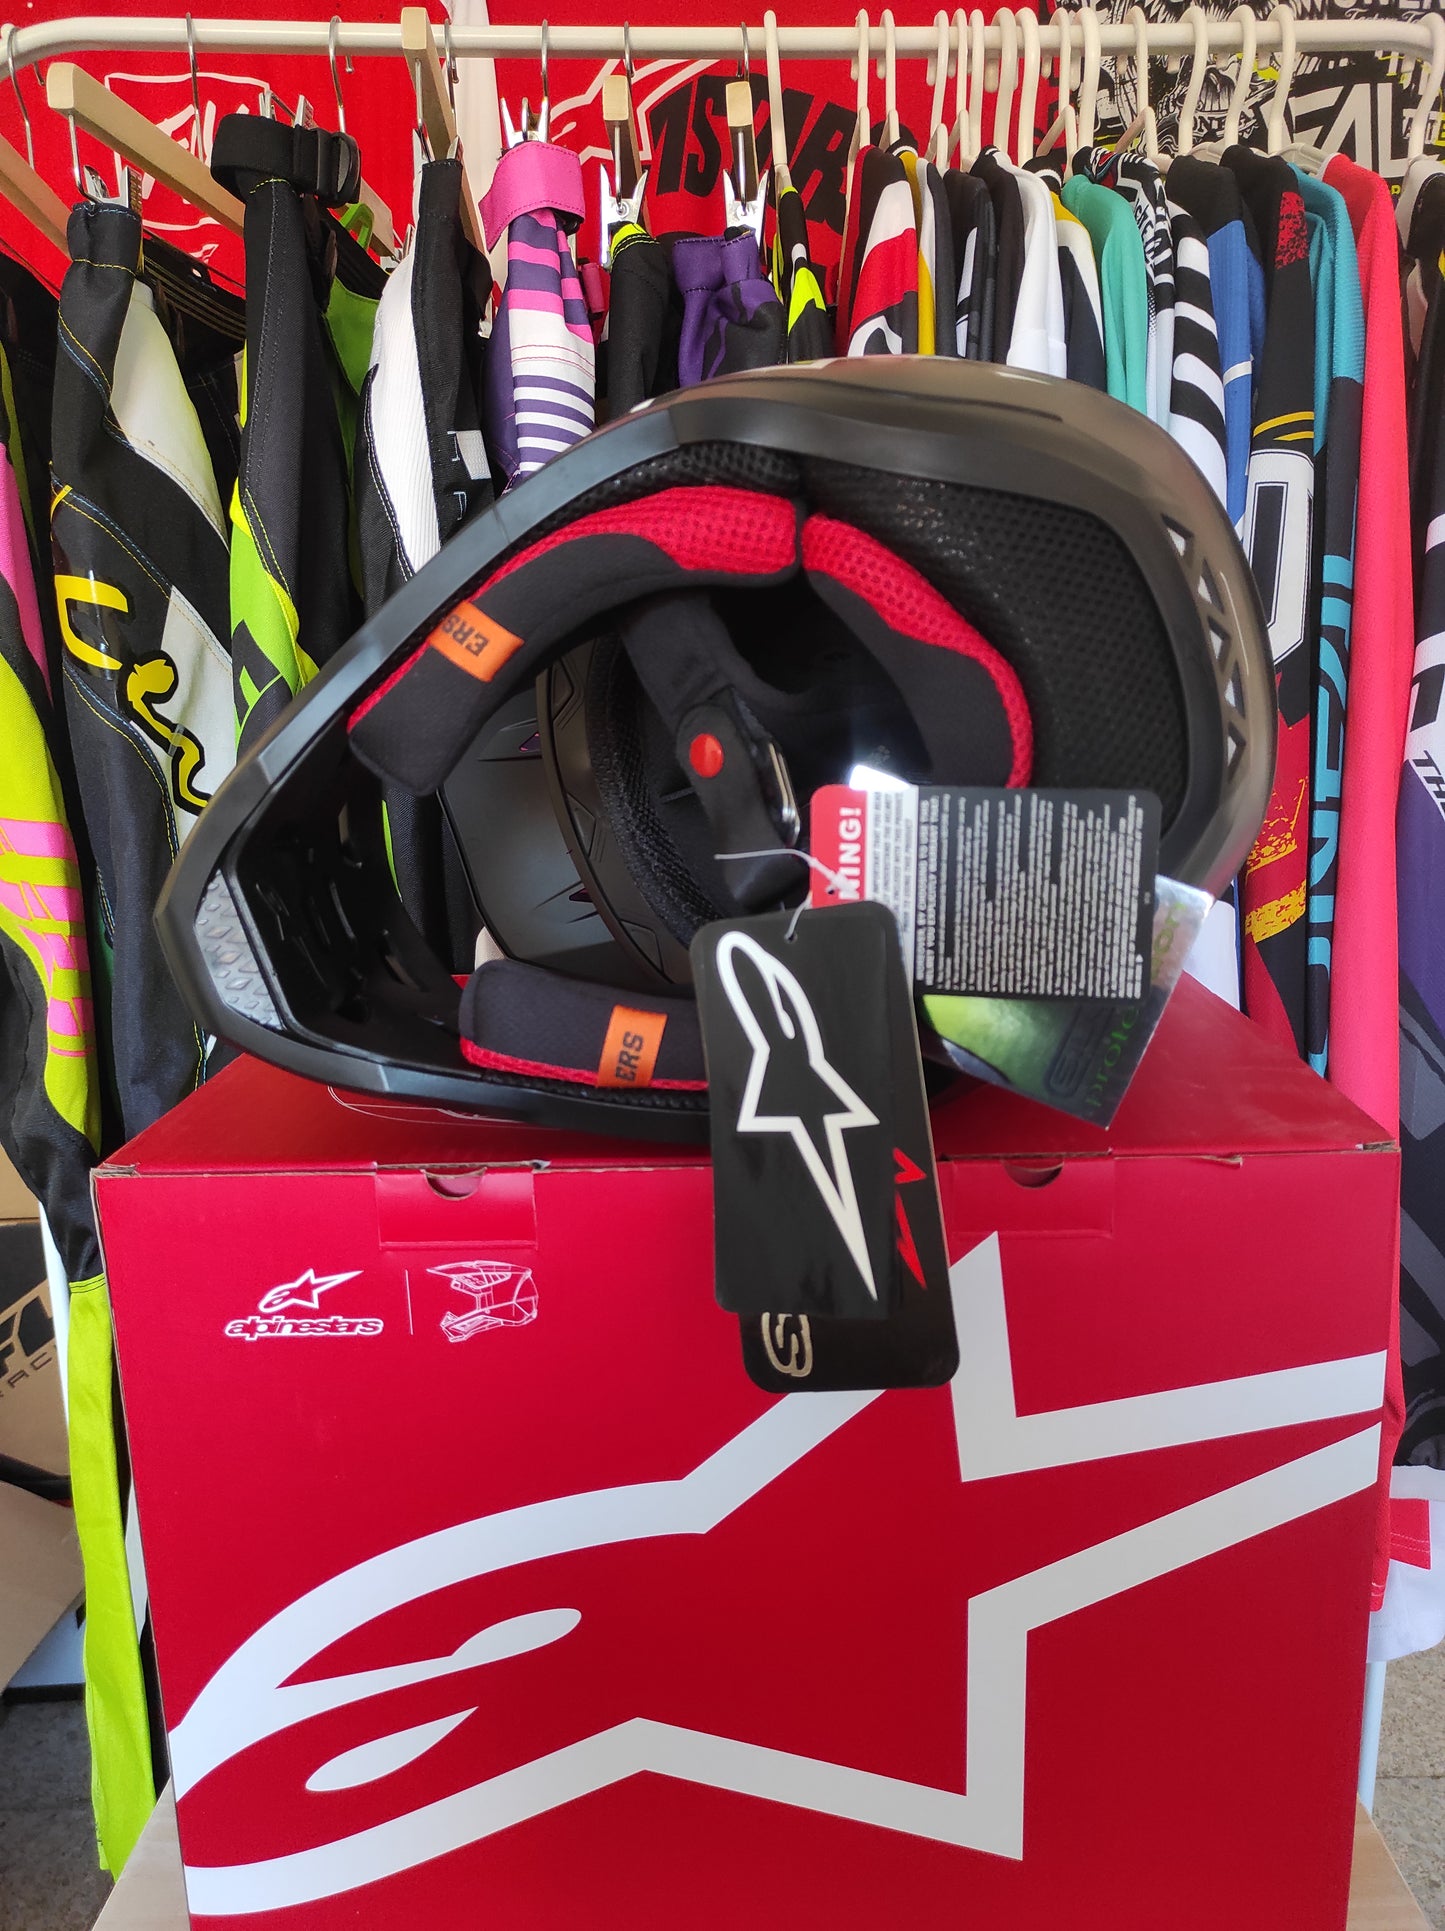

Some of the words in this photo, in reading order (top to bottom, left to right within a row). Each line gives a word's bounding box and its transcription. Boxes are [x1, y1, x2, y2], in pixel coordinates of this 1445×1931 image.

[441, 614, 489, 657] ERS
[615, 1031, 644, 1081] ERS
[225, 1316, 384, 1340] alpinestars
